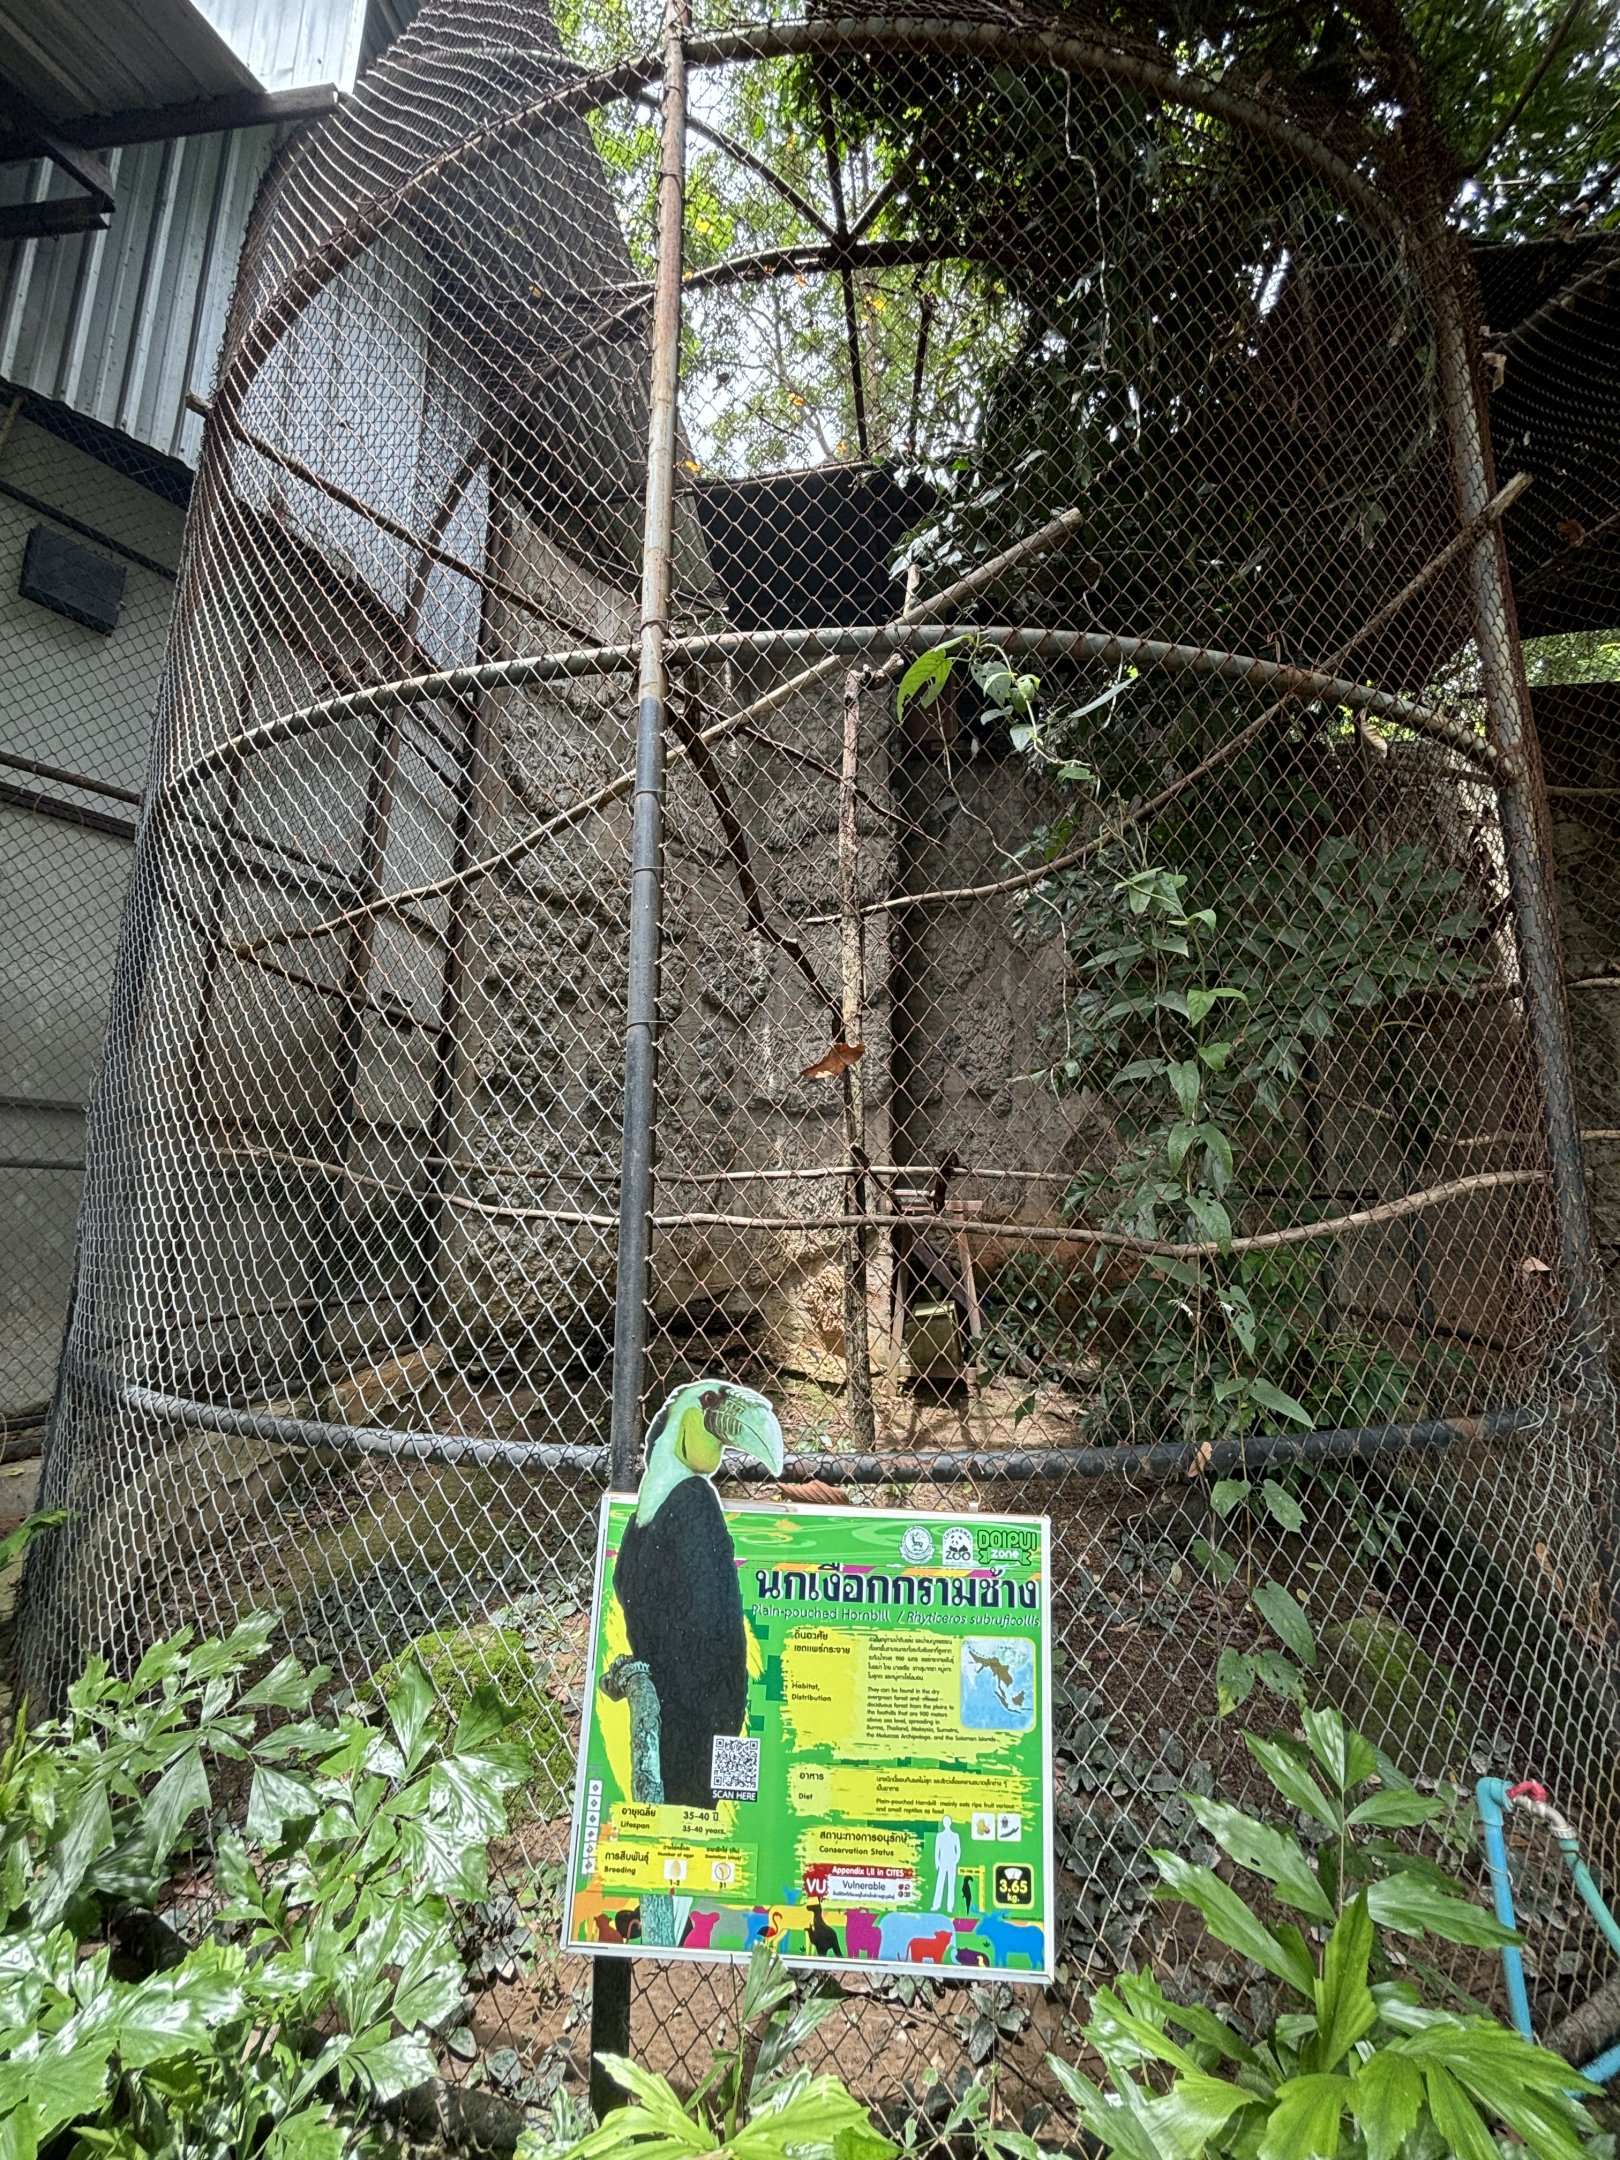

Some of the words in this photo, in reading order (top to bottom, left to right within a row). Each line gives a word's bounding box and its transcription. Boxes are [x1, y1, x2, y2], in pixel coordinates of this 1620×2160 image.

[977, 1529, 1038, 1552] DOIPUI
[945, 1550, 971, 1561] ZOO
[990, 1548, 1020, 1560] zone
[755, 1563, 1040, 1609] นกเงือกกรามช้าง
[752, 1604, 838, 1619] Plain-pouched
[842, 1605, 890, 1621] Hornbill
[907, 1611, 967, 1626] Rhyticeros
[970, 1613, 1040, 1629] subruficollis
[791, 1681, 820, 1692] Habitat,
[791, 1693, 832, 1702] Distribution
[799, 1772, 824, 1781] อาหาร
[712, 1789, 734, 1799] SCAN
[736, 1790, 756, 1801] HERE
[798, 1793, 813, 1801] Diet
[683, 1811, 709, 1821] 35-40
[620, 1821, 650, 1830] Lifespan
[682, 1825, 703, 1833] 35-40
[819, 1845, 868, 1856] Conservation
[870, 1848, 895, 1857] Status
[605, 1850, 649, 1865] การสืบพันธุ์
[604, 1865, 636, 1875] Breeding
[831, 1865, 865, 1876] Appendix
[877, 1868, 884, 1876] in
[885, 1869, 904, 1878] CITES
[806, 1877, 827, 1894] VU
[842, 1880, 886, 1891] Vulnerable
[999, 1878, 1028, 1894] 3.65
[1007, 1893, 1020, 1904] kg.
